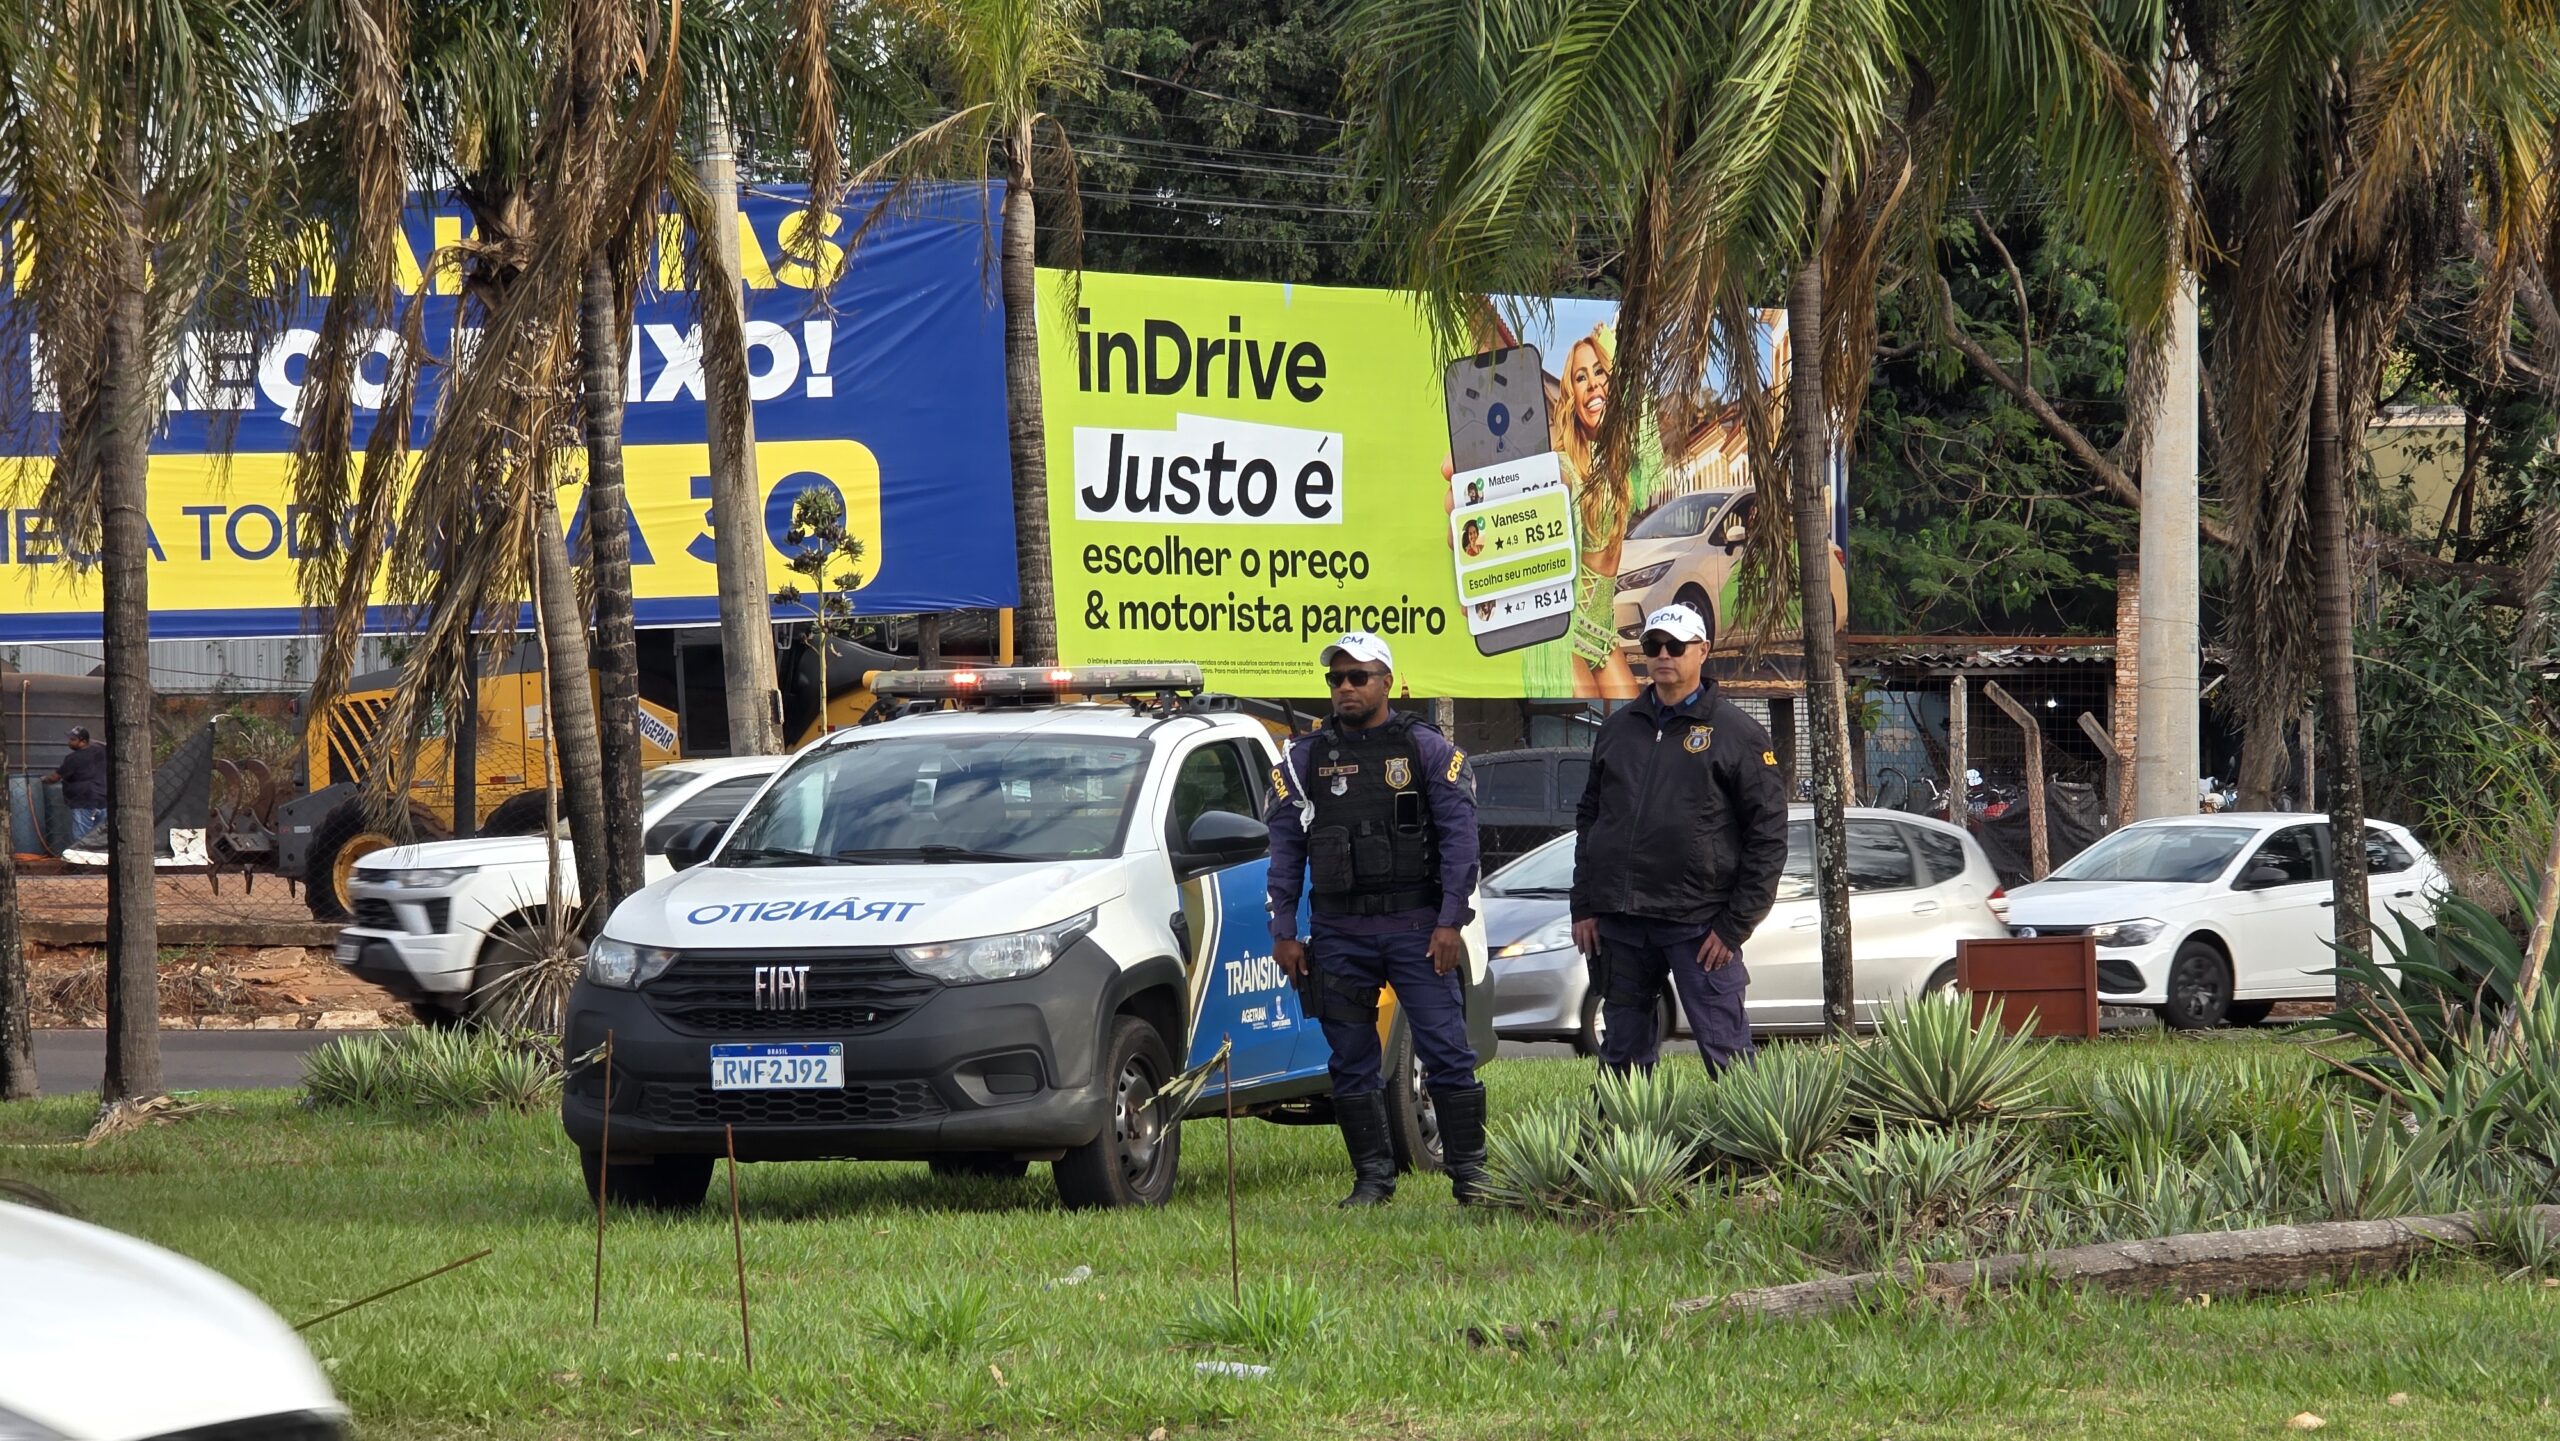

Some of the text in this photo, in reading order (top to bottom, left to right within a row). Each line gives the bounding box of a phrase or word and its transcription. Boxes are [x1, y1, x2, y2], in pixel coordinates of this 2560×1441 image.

[1077, 307, 1327, 403] inDrive
[1081, 433, 1334, 519] Justo é
[1488, 472, 1520, 487] Mateus
[1491, 508, 1538, 528] Vanessa
[1506, 520, 1564, 547] 4.9 R$ 12
[1082, 535, 1370, 589] escolher o preço
[1468, 557, 1567, 590] Escolha seu motorista
[1515, 588, 1568, 612] 4.7 R$ 14
[1084, 589, 1446, 644] & motorista parceiro
[1650, 612, 1683, 625] GCM
[1447, 750, 1465, 783] GCM
[1271, 768, 1289, 800] GCM
[755, 965, 810, 1011] FIAT
[767, 1048, 789, 1056] BRASIL
[723, 1058, 828, 1085] RWF2J92
